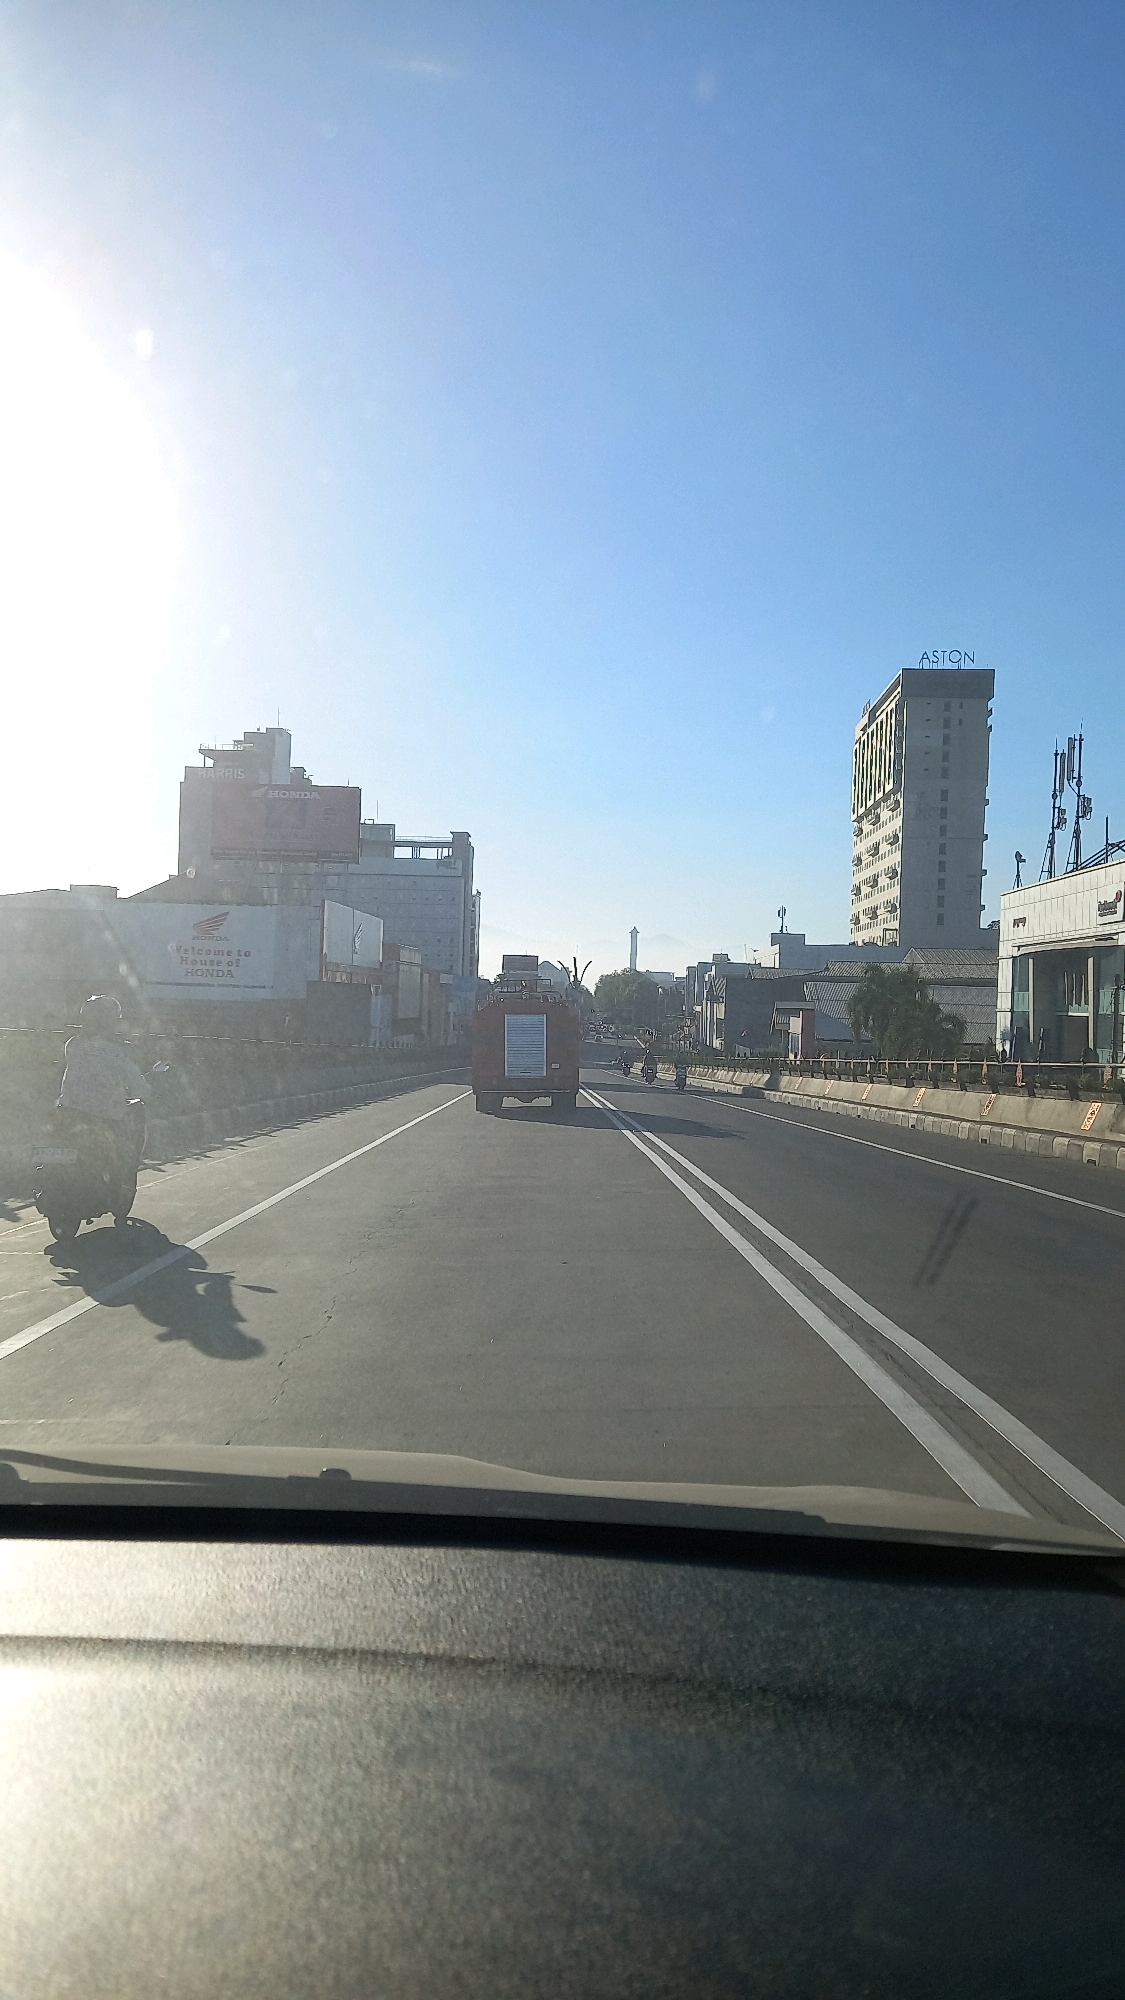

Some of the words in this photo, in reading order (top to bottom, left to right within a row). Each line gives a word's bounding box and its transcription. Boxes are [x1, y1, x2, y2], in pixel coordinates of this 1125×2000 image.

[920, 650, 975, 665] ASTON
[198, 768, 245, 779] HARRIS
[267, 790, 321, 799] HONDA
[236, 948, 251, 957] to
[179, 956, 223, 967] House
[226, 958, 241, 968] of
[184, 968, 235, 978] HONDA
